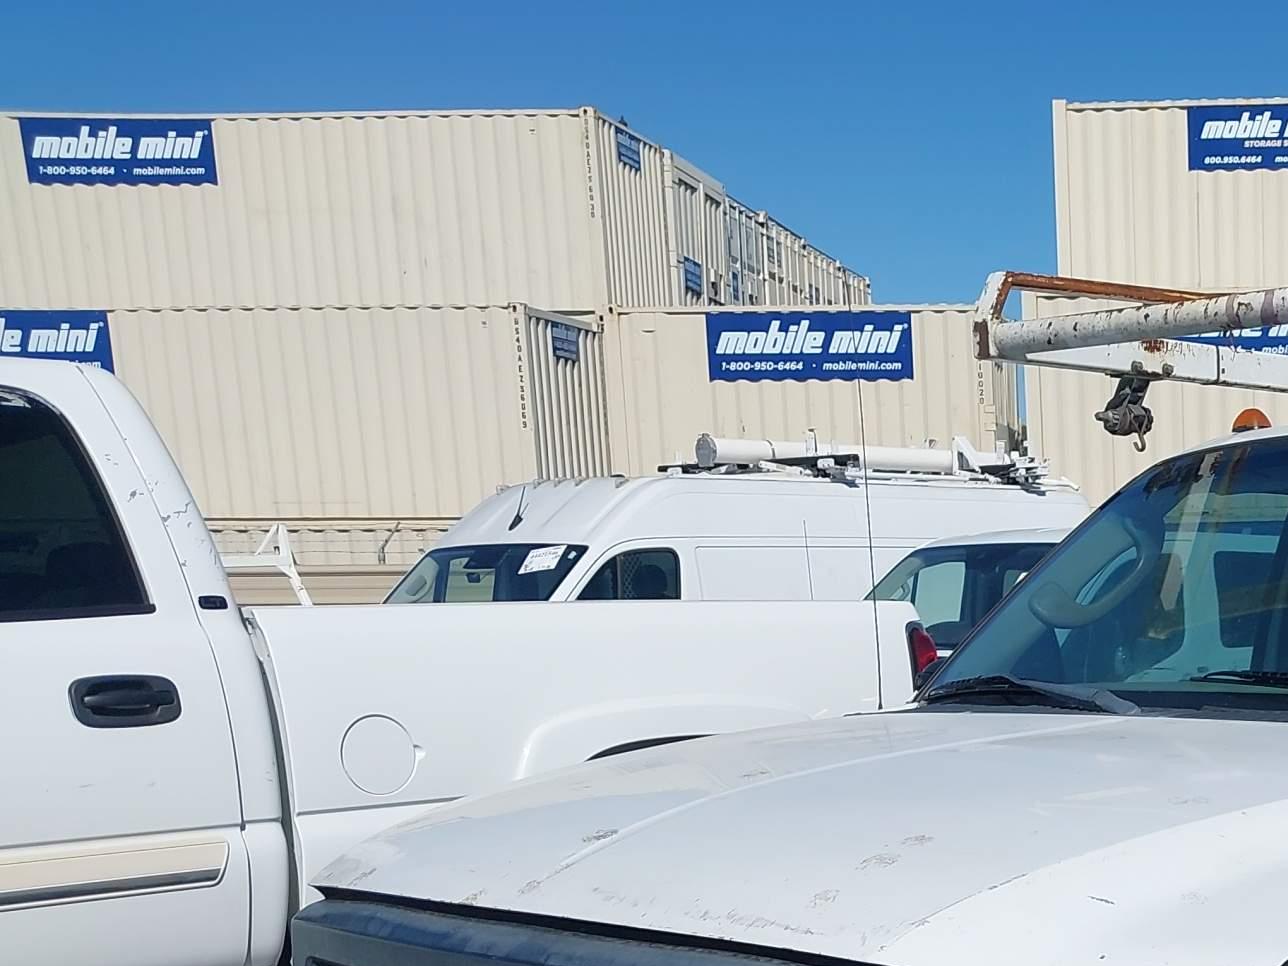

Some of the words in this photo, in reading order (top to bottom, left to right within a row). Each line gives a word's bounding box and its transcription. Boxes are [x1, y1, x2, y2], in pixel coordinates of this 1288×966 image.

[1200, 111, 1282, 139] mobile
[32, 126, 133, 160] mobile
[137, 131, 205, 160] mini
[1244, 140, 1282, 149] STORAGE
[39, 166, 115, 176] 1-800-950-6464
[133, 166, 205, 176] mobilemini.com
[27, 323, 99, 352] mini
[715, 320, 825, 354] mobile
[829, 324, 903, 354] mini
[721, 361, 804, 371] 1-800-950-6464
[823, 360, 902, 371] mobilemini.com
